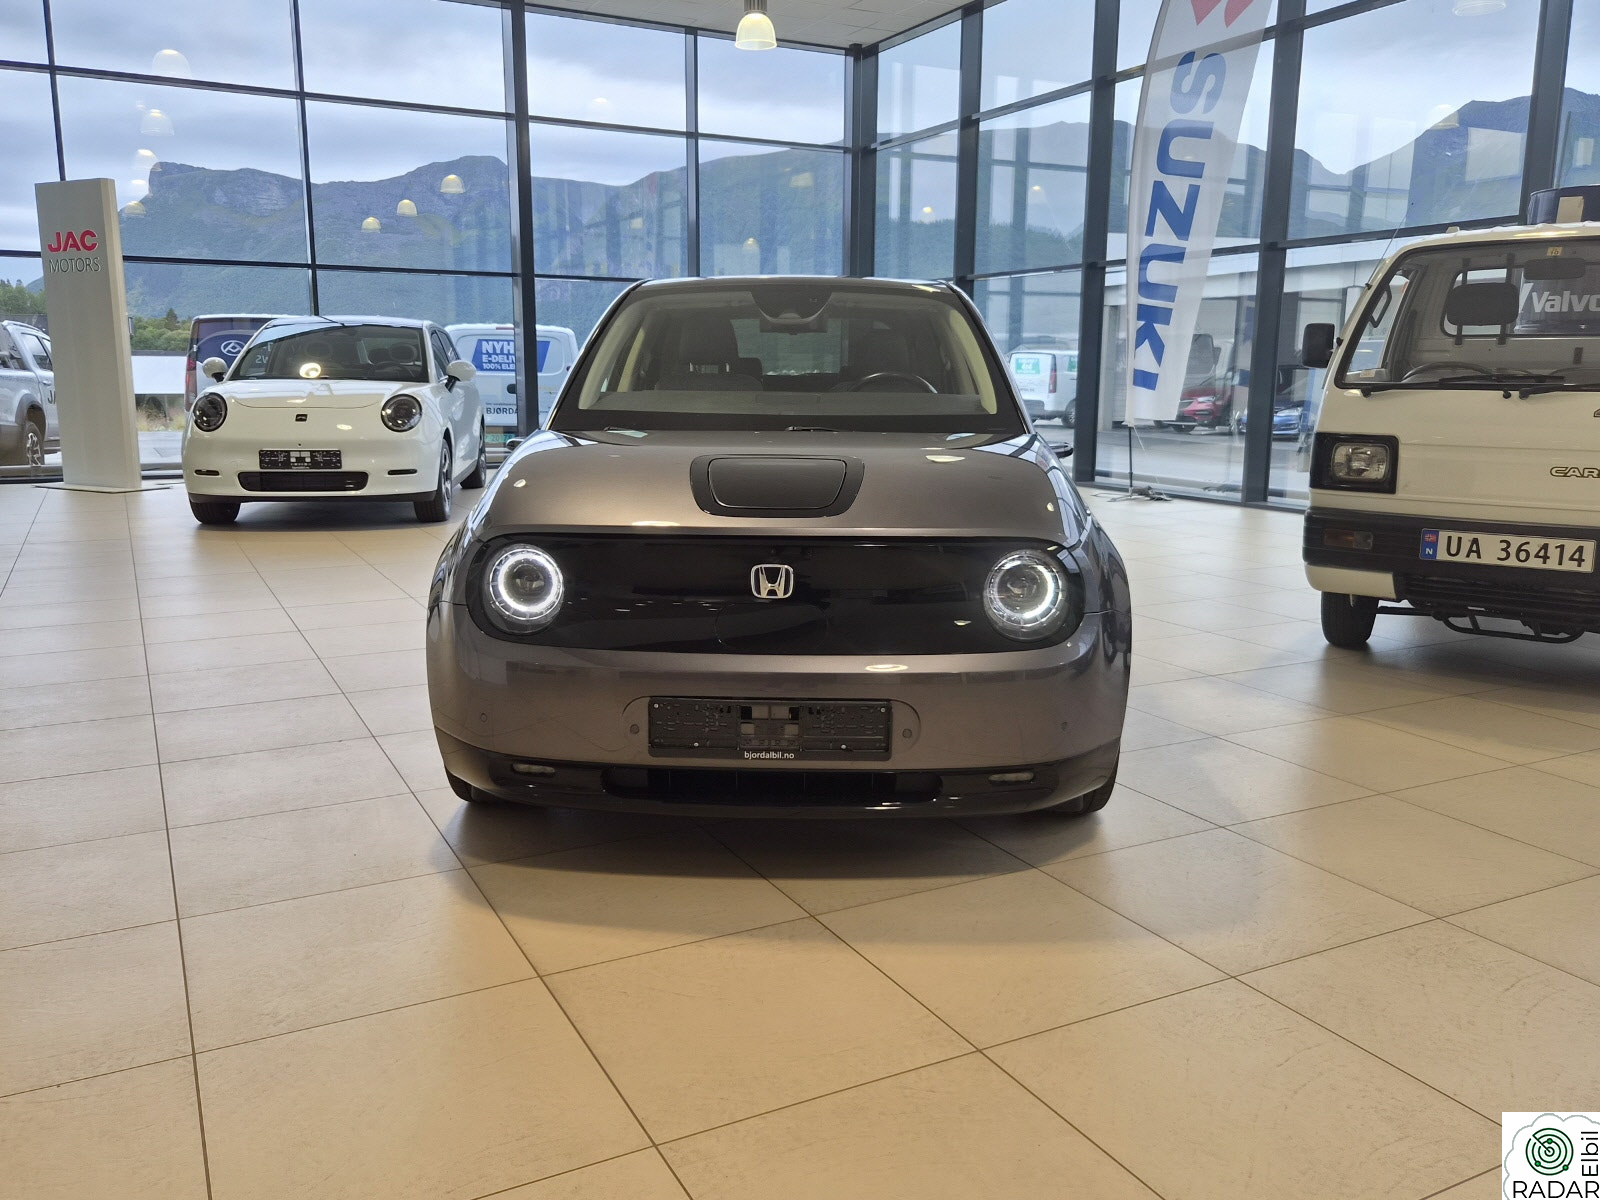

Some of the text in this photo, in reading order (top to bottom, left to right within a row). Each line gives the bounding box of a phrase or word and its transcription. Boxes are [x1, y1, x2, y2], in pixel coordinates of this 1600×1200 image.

[1133, 51, 1227, 391] SUZUKI
[47, 229, 99, 253] JAC
[49, 257, 101, 273] MOTORS
[1531, 290, 1600, 313] Valvo
[482, 340, 515, 354] NYH
[1550, 466, 1600, 479] CAR
[1446, 535, 1482, 560] UA
[1496, 539, 1586, 568] 36414
[744, 751, 795, 761] bjordalbil.no
